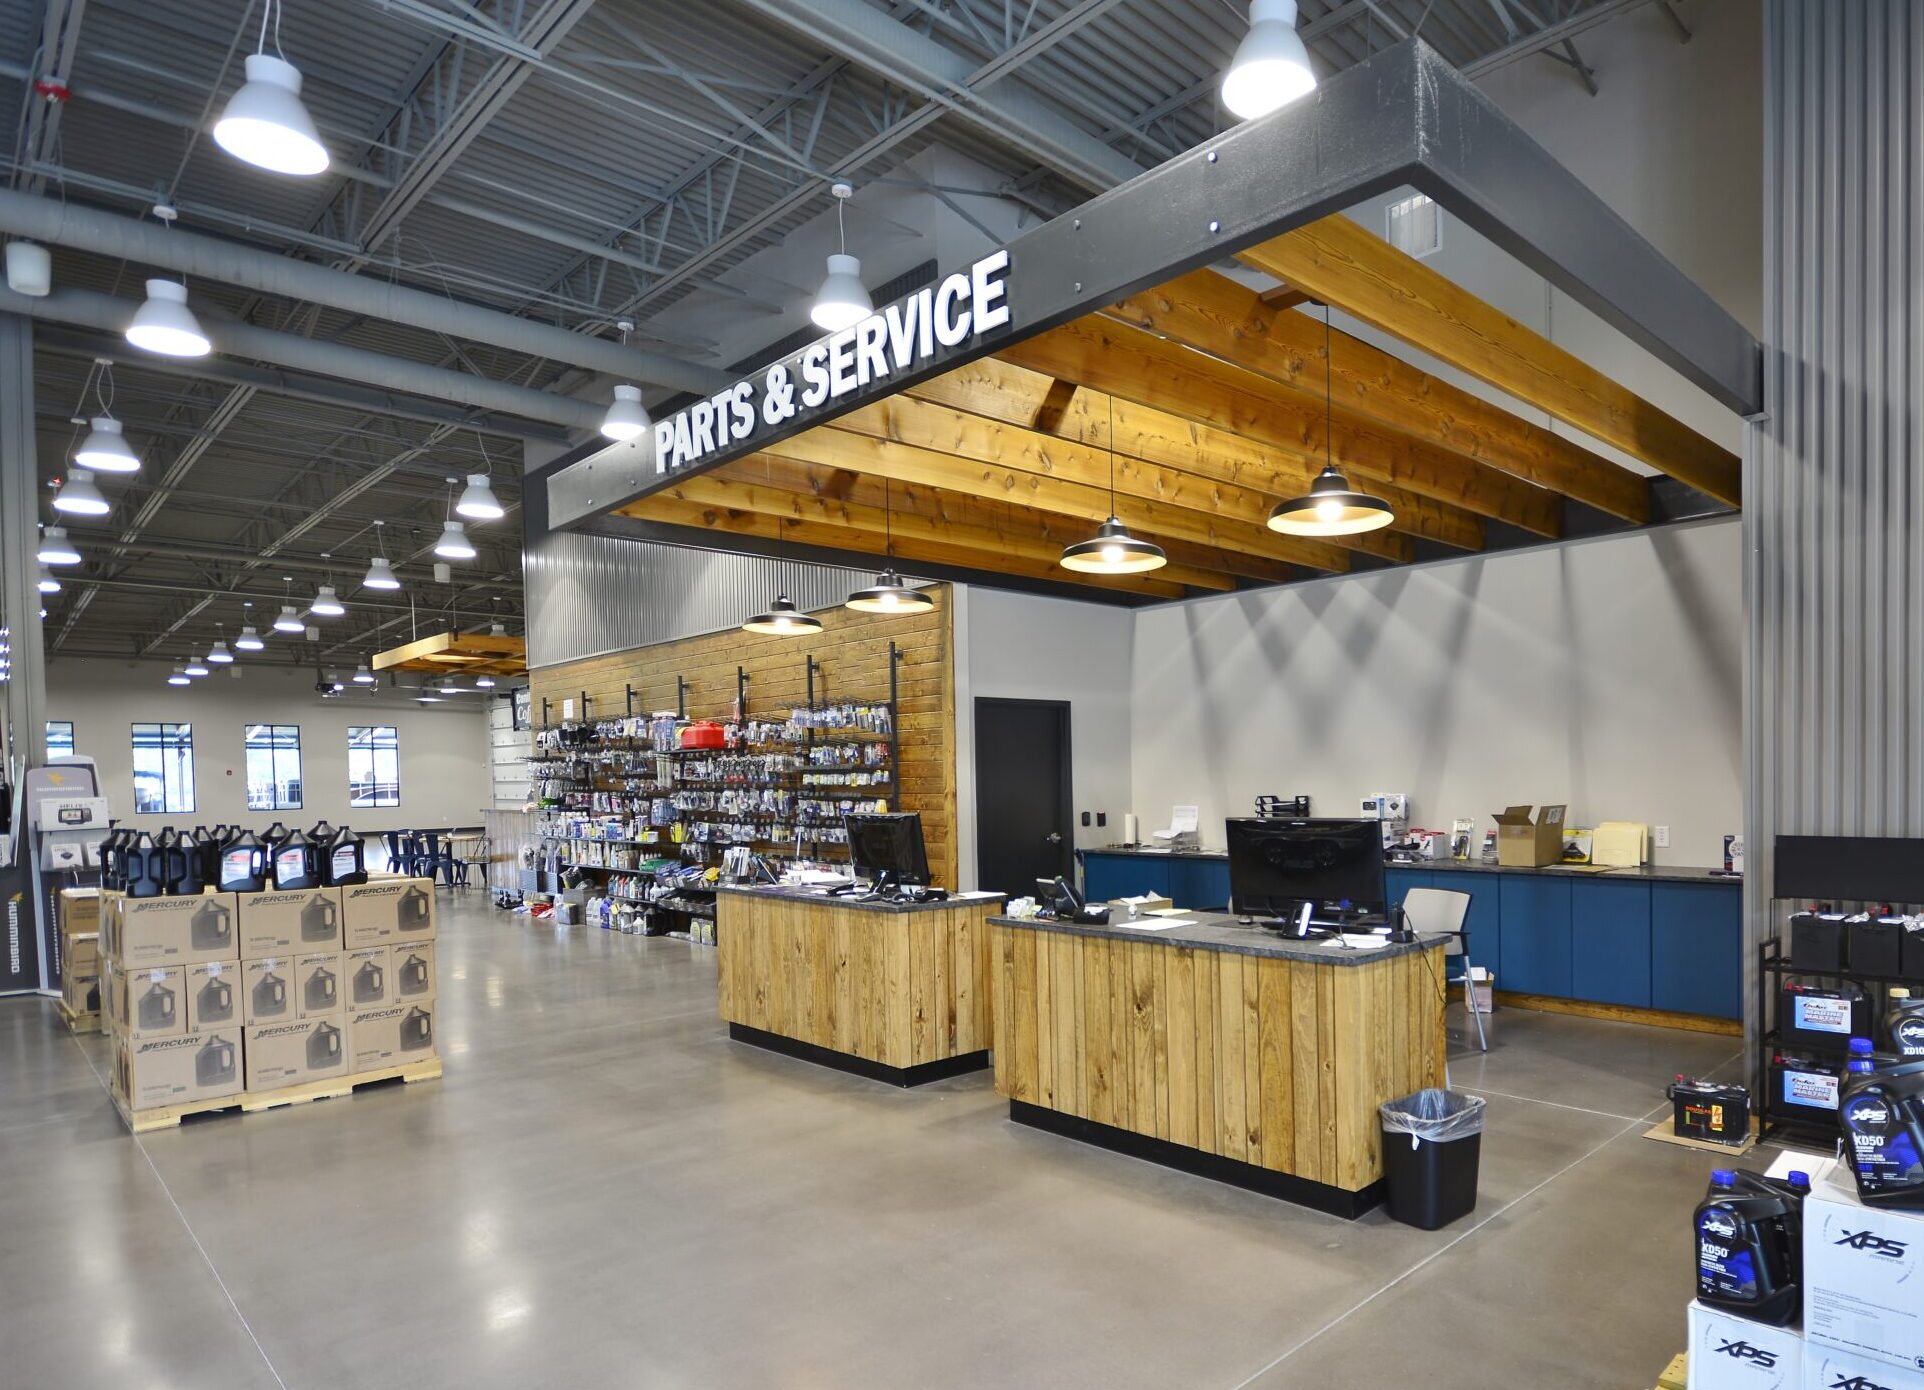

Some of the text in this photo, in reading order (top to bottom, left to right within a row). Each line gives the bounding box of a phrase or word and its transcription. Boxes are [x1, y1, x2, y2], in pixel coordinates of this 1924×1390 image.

[655, 250, 1009, 474] PARTS & SERVICE
[349, 886, 402, 898] MERCURY
[132, 900, 197, 913] MERCURY
[248, 894, 306, 907] MERCURY
[353, 1008, 405, 1024] MERCURY
[253, 1023, 312, 1040] MERCURY
[136, 1036, 201, 1054] MERCURY
[1851, 1108, 1887, 1120] XPS
[1854, 1135, 1884, 1147] XD50
[1701, 1220, 1735, 1236] XPS
[1702, 1243, 1728, 1258] XD50
[1833, 1229, 1910, 1258] XPS
[1713, 1338, 1780, 1368] XPS
[1828, 1373, 1893, 1390] XP
